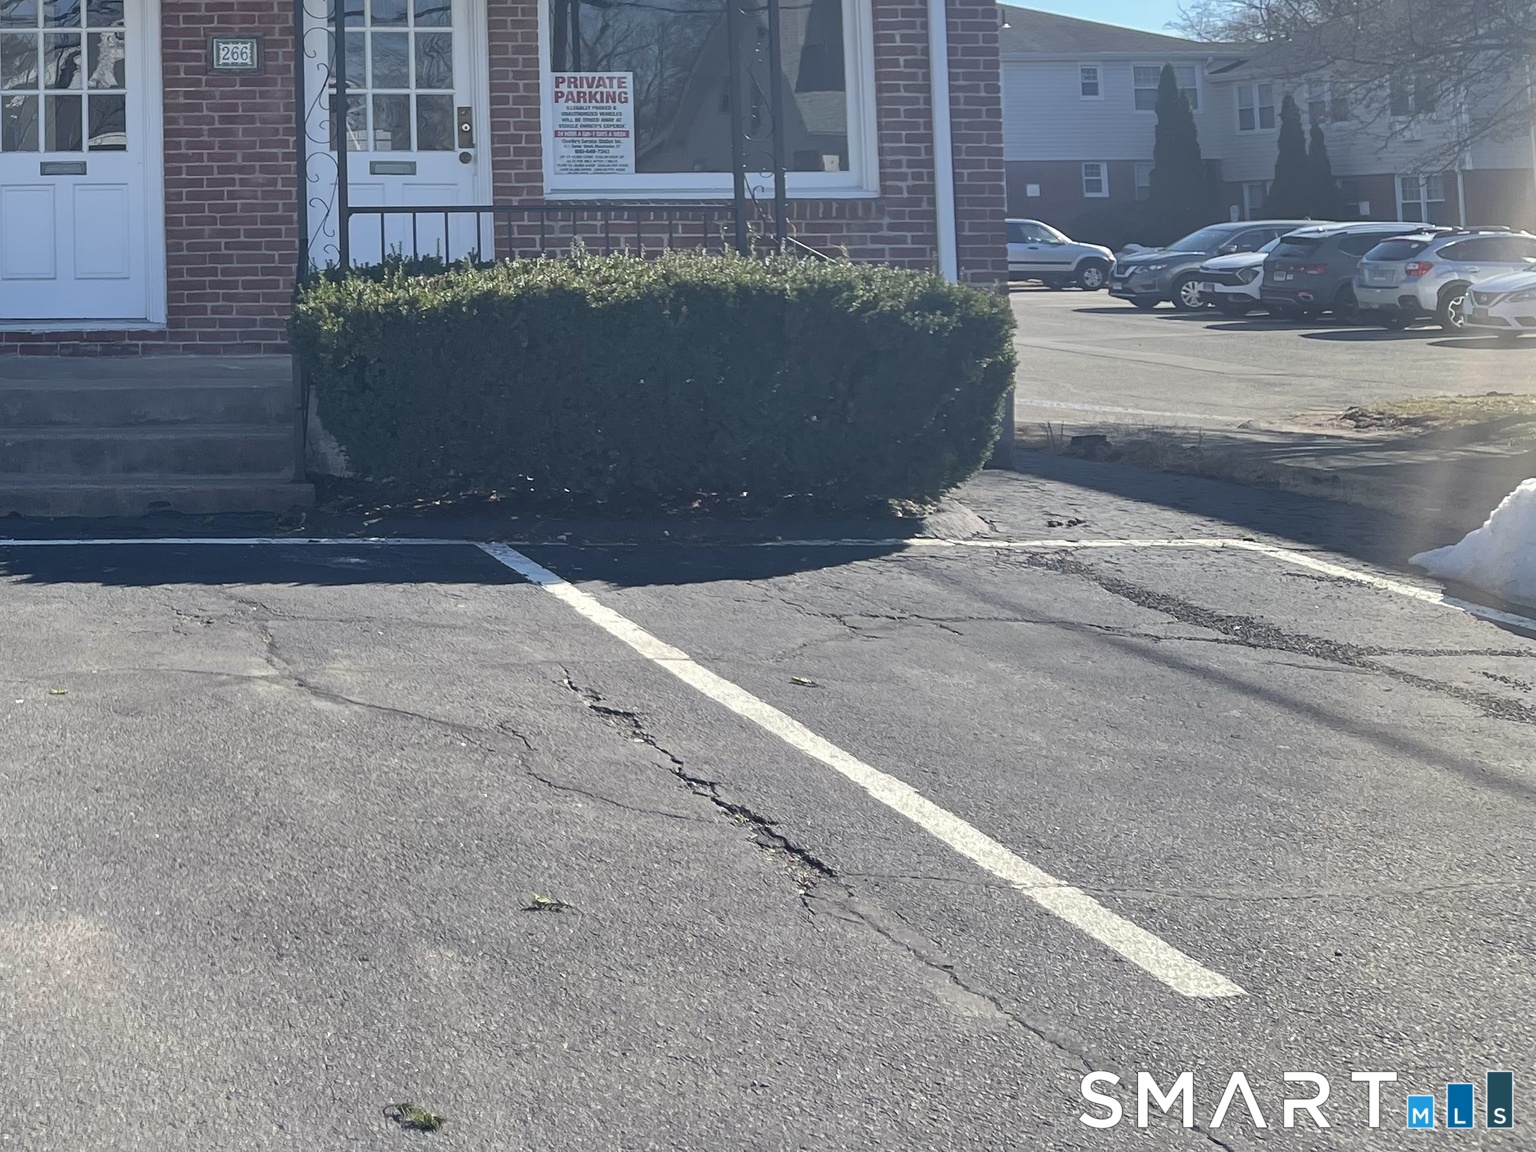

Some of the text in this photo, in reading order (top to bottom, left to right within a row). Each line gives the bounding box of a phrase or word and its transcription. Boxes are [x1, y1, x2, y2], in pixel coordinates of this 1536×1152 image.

[221, 46, 248, 61] 266
[554, 76, 627, 89] PRIVATE
[554, 90, 629, 104] PARKING
